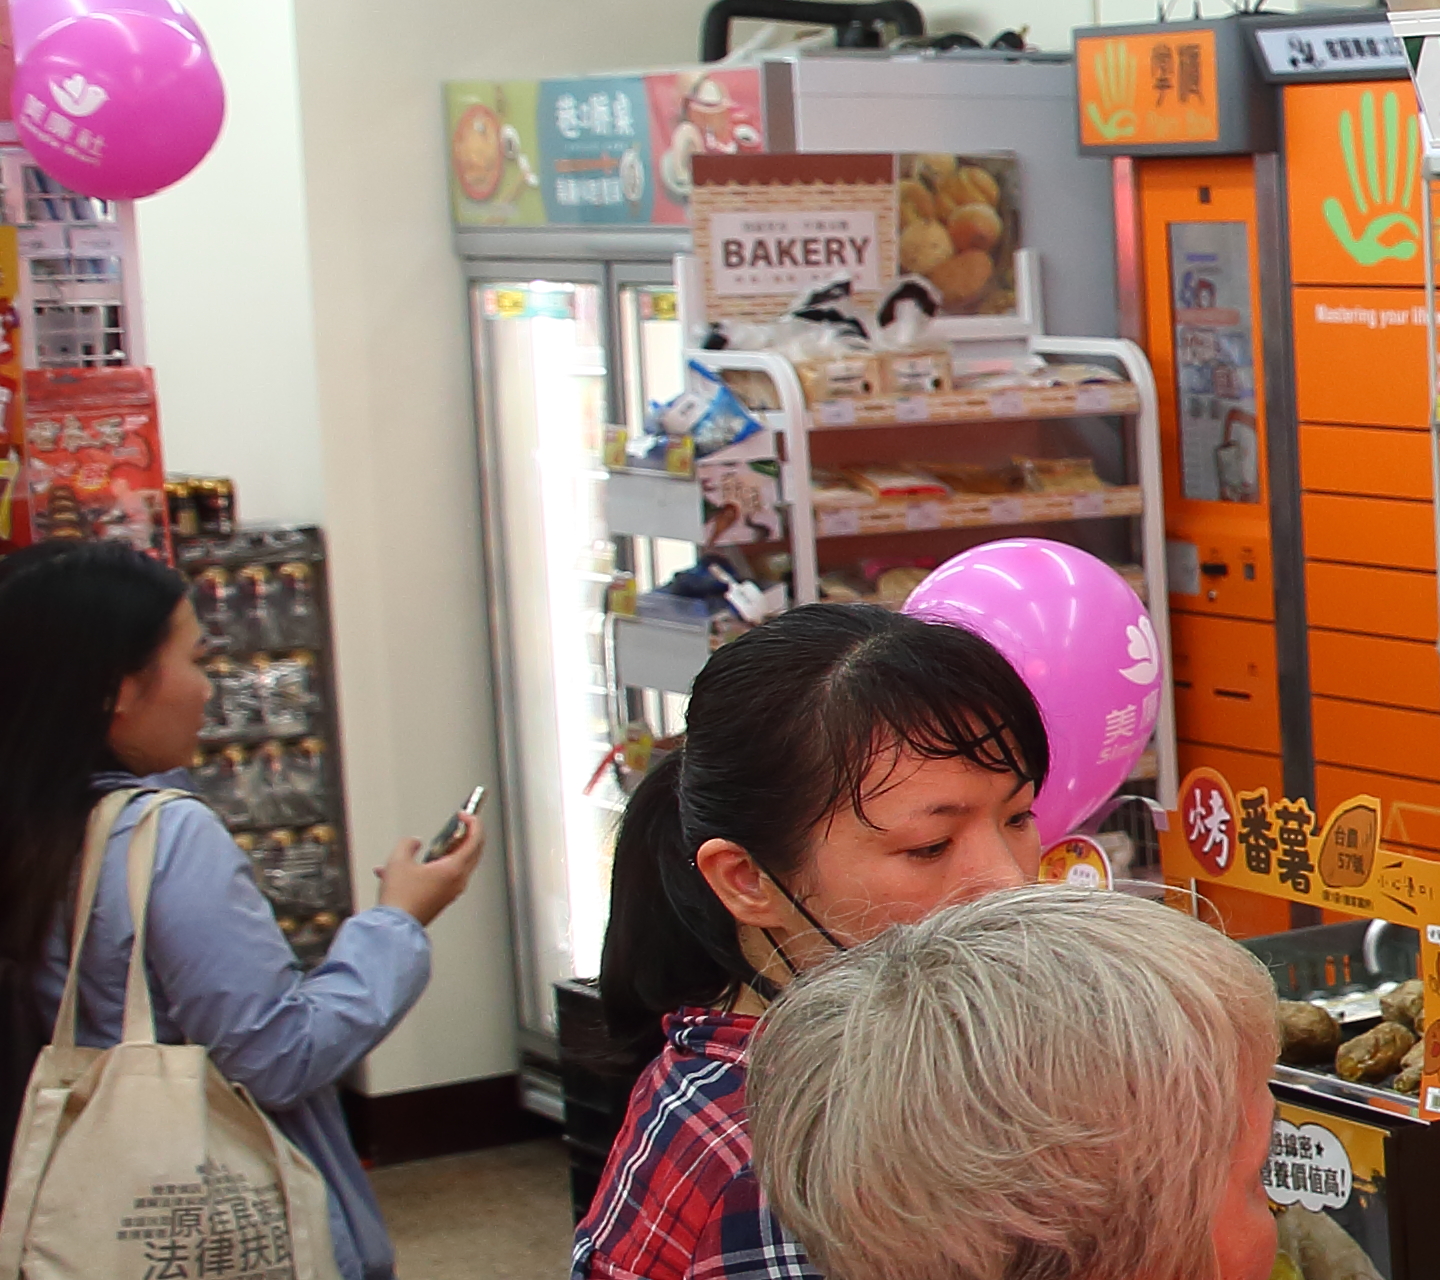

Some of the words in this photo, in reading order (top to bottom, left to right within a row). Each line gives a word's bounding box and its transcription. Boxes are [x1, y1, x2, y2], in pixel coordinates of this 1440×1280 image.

[722, 237, 871, 269] BAKERY
[1189, 788, 1231, 868] 烤
[1238, 794, 1315, 894] 番薯
